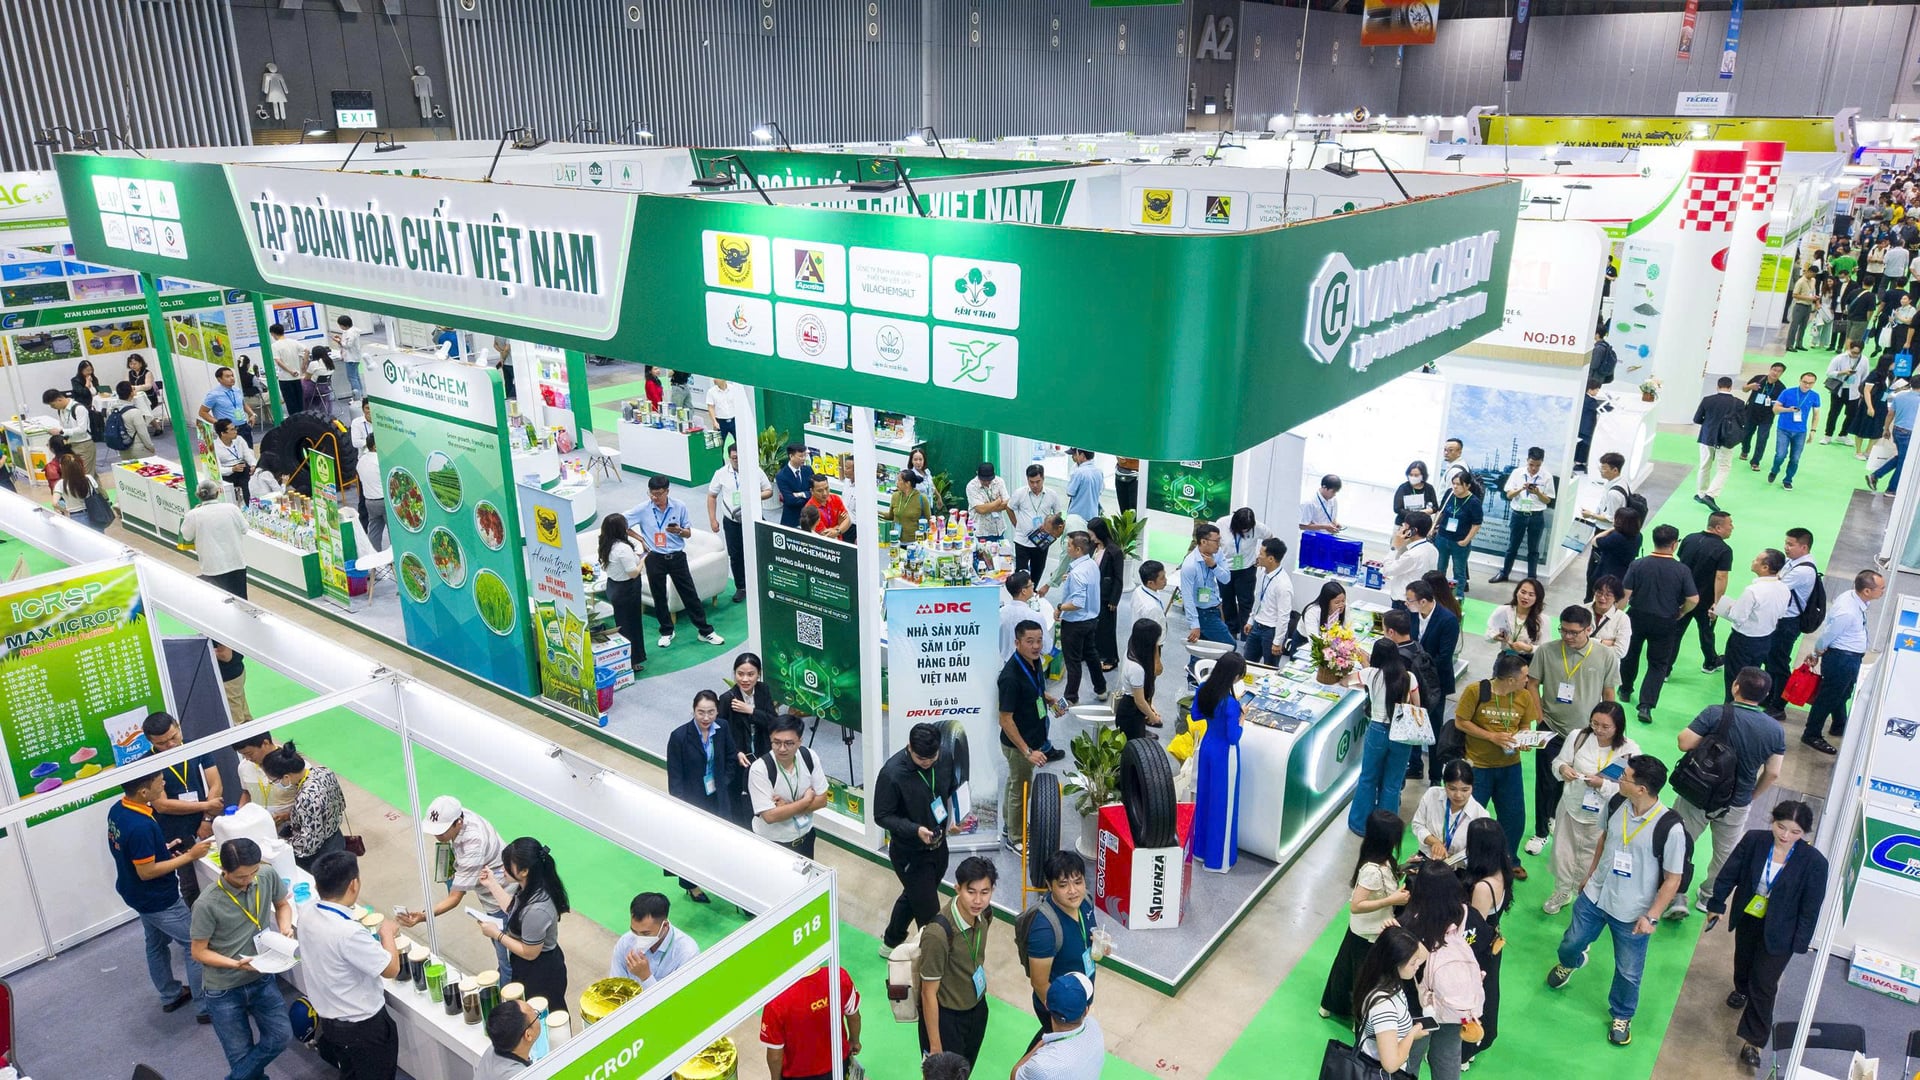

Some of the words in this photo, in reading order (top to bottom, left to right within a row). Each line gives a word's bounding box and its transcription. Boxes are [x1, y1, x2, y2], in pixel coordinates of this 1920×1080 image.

[1196, 14, 1234, 60] A2
[341, 112, 373, 123] EXIT
[986, 188, 1044, 224] NAM
[250, 193, 287, 262] TẬP
[290, 196, 350, 259] ĐOÀN
[350, 202, 400, 267] HÓA
[400, 199, 463, 276] CHẤT
[466, 212, 523, 296] VIỆT
[529, 230, 598, 295] NAM
[64, 311, 81, 319] XI'AN
[82, 306, 117, 316] SUNMATTE
[117, 303, 148, 313] TECHNOL
[1523, 331, 1576, 346] NO:D18
[786, 543, 841, 564] VINACHEMMART
[934, 602, 971, 614] DRC
[5, 625, 53, 649] MAX
[59, 607, 121, 635] ICROP
[907, 623, 928, 637] NHÀ
[932, 623, 951, 636] SẢN
[955, 621, 981, 635] XUẤT
[20, 645, 44, 657] Water
[921, 639, 943, 652] SĂM
[946, 637, 966, 652] LỐP
[917, 655, 946, 668] HÀNG
[949, 653, 970, 667] ĐẦU
[920, 671, 942, 686] VIỆT
[944, 672, 967, 683] NAM
[929, 697, 942, 707] Lốp
[950, 696, 958, 705] tô
[906, 707, 981, 718] DRIVEFORCE
[126, 743, 141, 753] MAX
[1875, 782, 1888, 792] Áp
[1889, 784, 1908, 797] Mới
[1097, 829, 1107, 898] COVERER
[793, 915, 822, 947] B18
[1861, 974, 1908, 993] BIWASE
